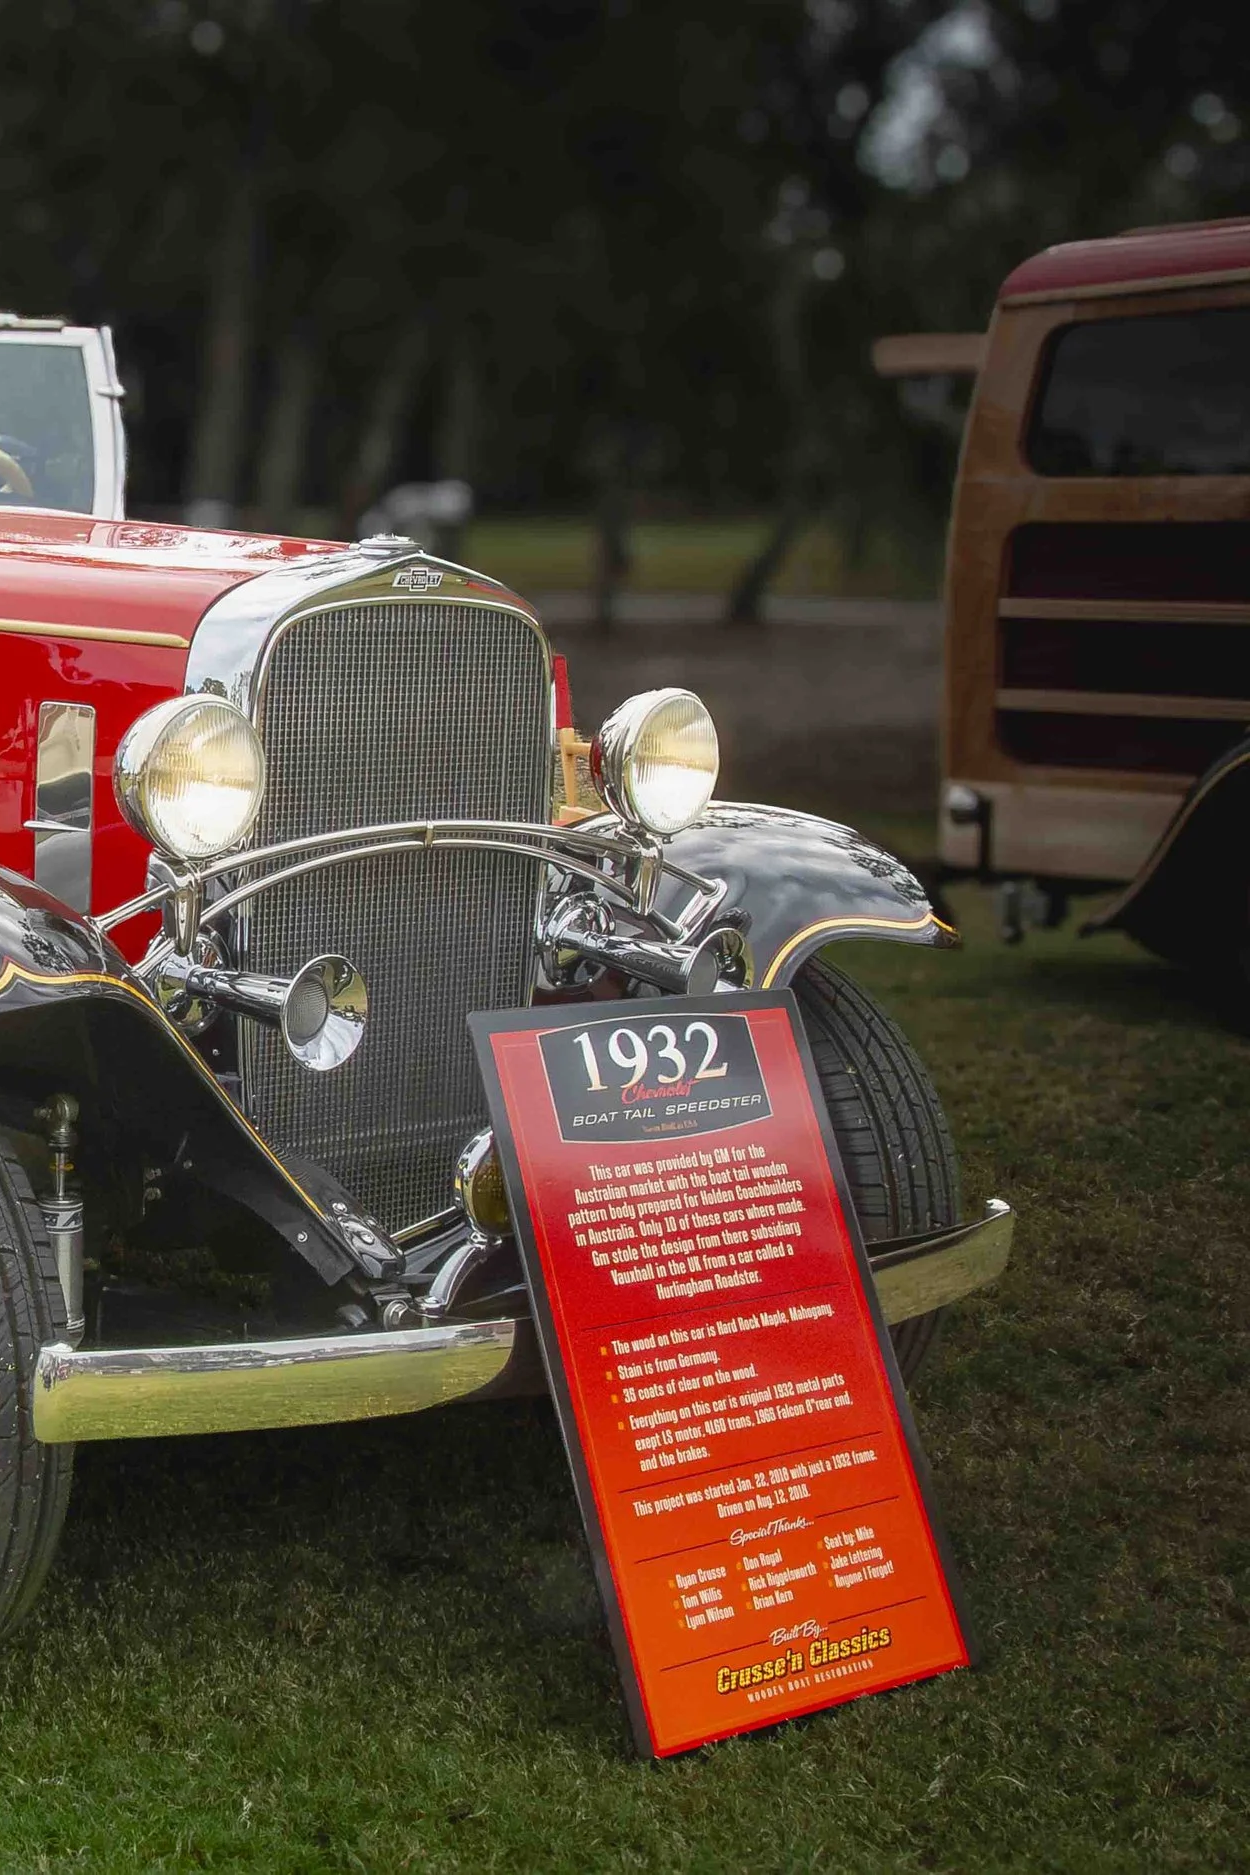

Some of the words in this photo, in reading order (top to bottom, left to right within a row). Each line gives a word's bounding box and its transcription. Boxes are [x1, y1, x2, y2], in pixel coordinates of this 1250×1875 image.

[573, 1022, 728, 1092] 1932
[621, 1078, 699, 1105] Chevrolet
[572, 1111, 619, 1127] BOAT
[622, 1107, 656, 1120] TAIL
[665, 1094, 762, 1116] SPEEDSTER
[588, 1164, 613, 1182] This
[614, 1164, 631, 1178] car
[632, 1161, 655, 1176] was
[655, 1151, 699, 1176] provided
[698, 1150, 714, 1169] by
[713, 1147, 731, 1164] GM
[730, 1146, 747, 1162] for
[747, 1143, 766, 1160] the
[574, 1183, 629, 1206] Australian
[628, 1177, 666, 1197] market
[665, 1173, 690, 1192] with
[689, 1171, 709, 1188] the
[707, 1168, 733, 1186] boat
[732, 1164, 751, 1182] tail
[750, 1160, 789, 1180] wooden
[567, 1208, 609, 1230] pattern
[607, 1201, 637, 1220] body
[636, 1193, 683, 1219] prepared
[683, 1192, 700, 1209] for
[699, 1187, 736, 1206] Holden
[734, 1177, 804, 1201] Coachbuilders
[574, 1230, 588, 1248] in
[587, 1223, 639, 1246] Australia.
[638, 1218, 664, 1238] Only
[663, 1215, 678, 1233] 10
[678, 1213, 691, 1231] of
[690, 1211, 722, 1229] these
[722, 1208, 746, 1224] cars
[744, 1203, 776, 1220] where
[776, 1196, 807, 1216] made.
[591, 1249, 611, 1267] Gm
[611, 1244, 640, 1264] stole
[639, 1241, 660, 1260] the
[660, 1236, 696, 1256] design
[695, 1233, 722, 1250] from
[720, 1228, 750, 1246] there
[749, 1220, 802, 1241] subsidiary
[609, 1262, 656, 1286] Vauxhall
[654, 1262, 668, 1279] in
[667, 1259, 688, 1277] the
[686, 1255, 703, 1273] UK
[701, 1253, 729, 1271] from
[728, 1253, 737, 1266] a
[736, 1249, 755, 1265] car
[754, 1240, 786, 1262] called
[785, 1243, 795, 1256] a
[655, 1277, 715, 1301] Hurlingham
[713, 1269, 763, 1290] Roadster.
[610, 1339, 631, 1356] The
[630, 1332, 657, 1353] wood
[656, 1333, 671, 1348] on
[669, 1327, 690, 1345] this
[689, 1326, 708, 1341] car
[705, 1322, 717, 1338] is
[715, 1317, 739, 1336] Hard
[736, 1313, 761, 1332] Rock
[616, 1362, 644, 1381] Stain
[642, 1360, 655, 1376] is
[653, 1357, 679, 1373] from
[677, 1350, 721, 1368] Germany.
[637, 1383, 666, 1401] coats
[665, 1378, 677, 1395] of
[677, 1375, 701, 1393] clear
[701, 1374, 716, 1388] on
[714, 1368, 733, 1385] the
[731, 1362, 759, 1382] wood.
[628, 1408, 679, 1431] Everything
[678, 1406, 692, 1420] on
[691, 1400, 712, 1417] this
[711, 1398, 728, 1413] car
[727, 1394, 739, 1410] is
[738, 1385, 773, 1407] original
[772, 1381, 796, 1400] 1932
[794, 1375, 822, 1395] metal
[820, 1372, 846, 1392] parts
[634, 1432, 663, 1452] exept
[661, 1428, 674, 1446] LS
[775, 1403, 806, 1420] Falcon
[639, 1453, 659, 1472] and
[658, 1451, 677, 1468] the
[632, 1499, 654, 1517] This
[653, 1492, 686, 1515] project
[684, 1490, 704, 1505] was
[703, 1479, 736, 1501] started
[735, 1477, 755, 1493] Jan.
[788, 1462, 809, 1480] with
[807, 1459, 826, 1478] just
[824, 1459, 833, 1472] a
[831, 1451, 853, 1470] 1932
[851, 1449, 878, 1465] frame.
[716, 1501, 745, 1519] Driven
[743, 1498, 757, 1512] on
[755, 1494, 775, 1510] Aug.
[729, 1521, 776, 1547] Special
[823, 1533, 844, 1550] Seat
[854, 1525, 875, 1542] Mike
[758, 1548, 783, 1567] Royal
[829, 1553, 850, 1570] Jake
[675, 1573, 698, 1590] Ryan
[696, 1566, 727, 1584] Crusse
[747, 1574, 768, 1592] Rick
[833, 1571, 864, 1589] Anyone
[862, 1566, 868, 1581] I
[680, 1594, 700, 1610] Tom
[684, 1613, 707, 1631] Lynn
[704, 1605, 735, 1624] Wilson
[752, 1594, 776, 1611] Brian
[768, 1624, 800, 1646] Built
[717, 1649, 807, 1695] Crusse'n
[809, 1627, 890, 1666] Classics
[746, 1684, 784, 1703] WOODEN
[787, 1676, 811, 1692] BOAT
[813, 1658, 874, 1684] RESTORATION
